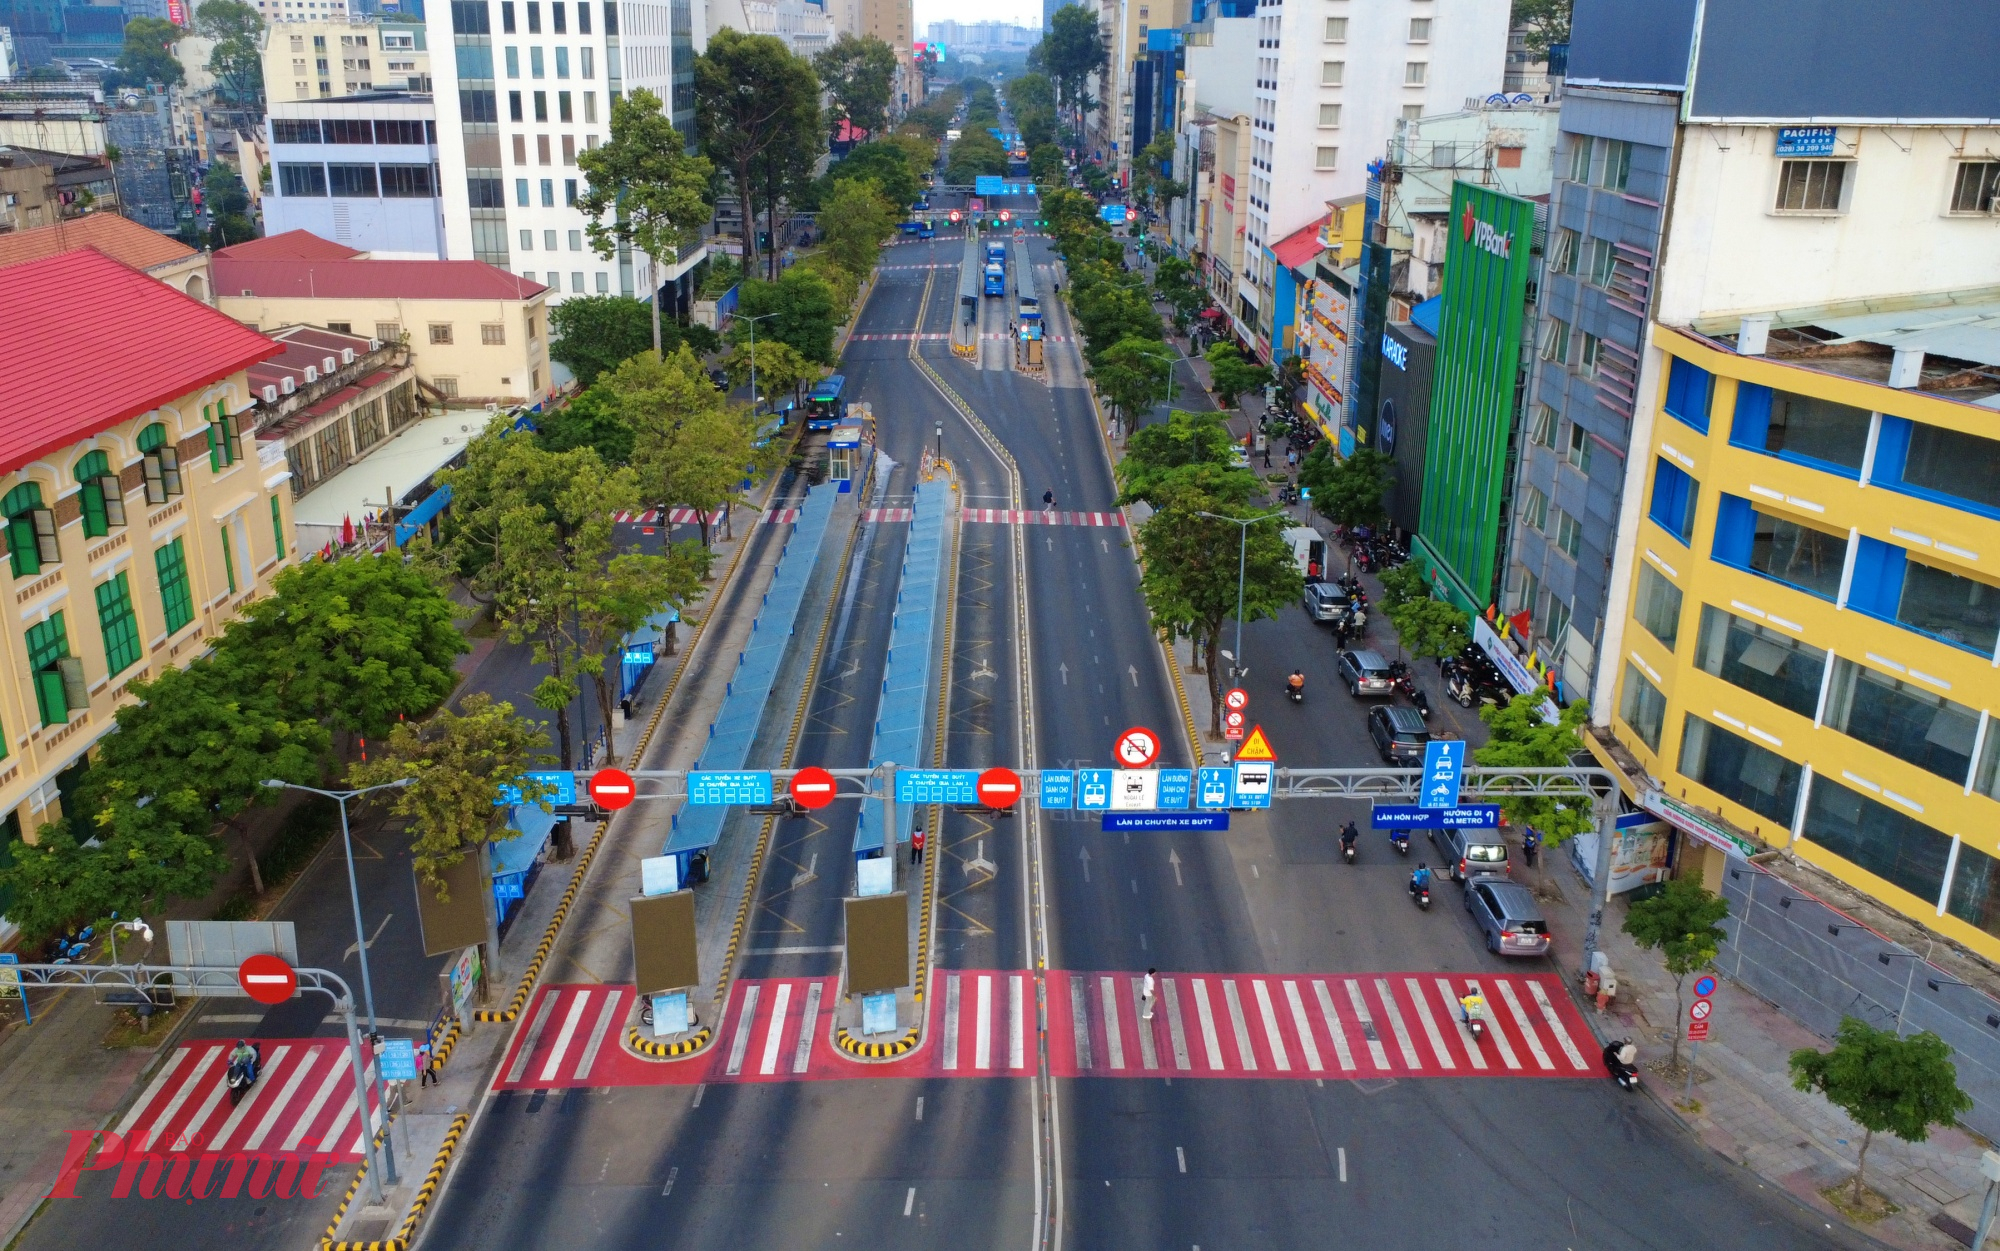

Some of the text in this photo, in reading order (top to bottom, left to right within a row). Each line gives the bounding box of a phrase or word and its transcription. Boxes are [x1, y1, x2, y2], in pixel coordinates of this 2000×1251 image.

[1784, 128, 1832, 138] PACIFIC
[1473, 218, 1514, 259] VPBank
[1382, 332, 1408, 371] KARAOKE
[1247, 747, 1264, 755] CHẬM
[1044, 774, 1054, 782] LÀN
[1162, 774, 1172, 782] LÀN
[1046, 785, 1058, 793] DÀNH
[1163, 785, 1176, 793] DÀNH
